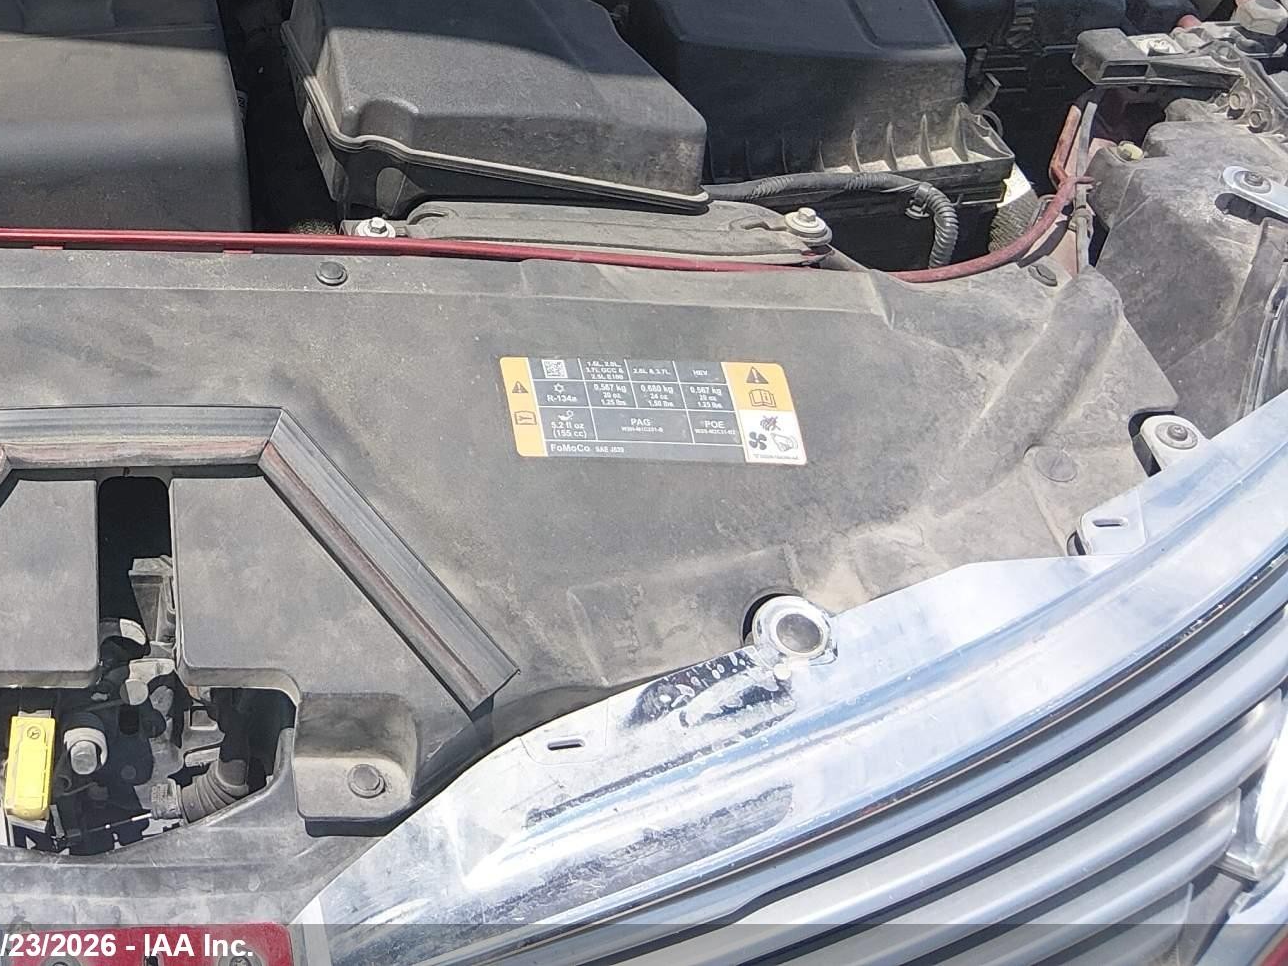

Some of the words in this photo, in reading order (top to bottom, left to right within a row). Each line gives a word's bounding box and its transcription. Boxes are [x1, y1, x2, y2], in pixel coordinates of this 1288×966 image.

[546, 394, 578, 403] R-134a
[630, 417, 651, 426] PAG
[704, 420, 725, 429] POE
[550, 443, 591, 453] FoMoCo
